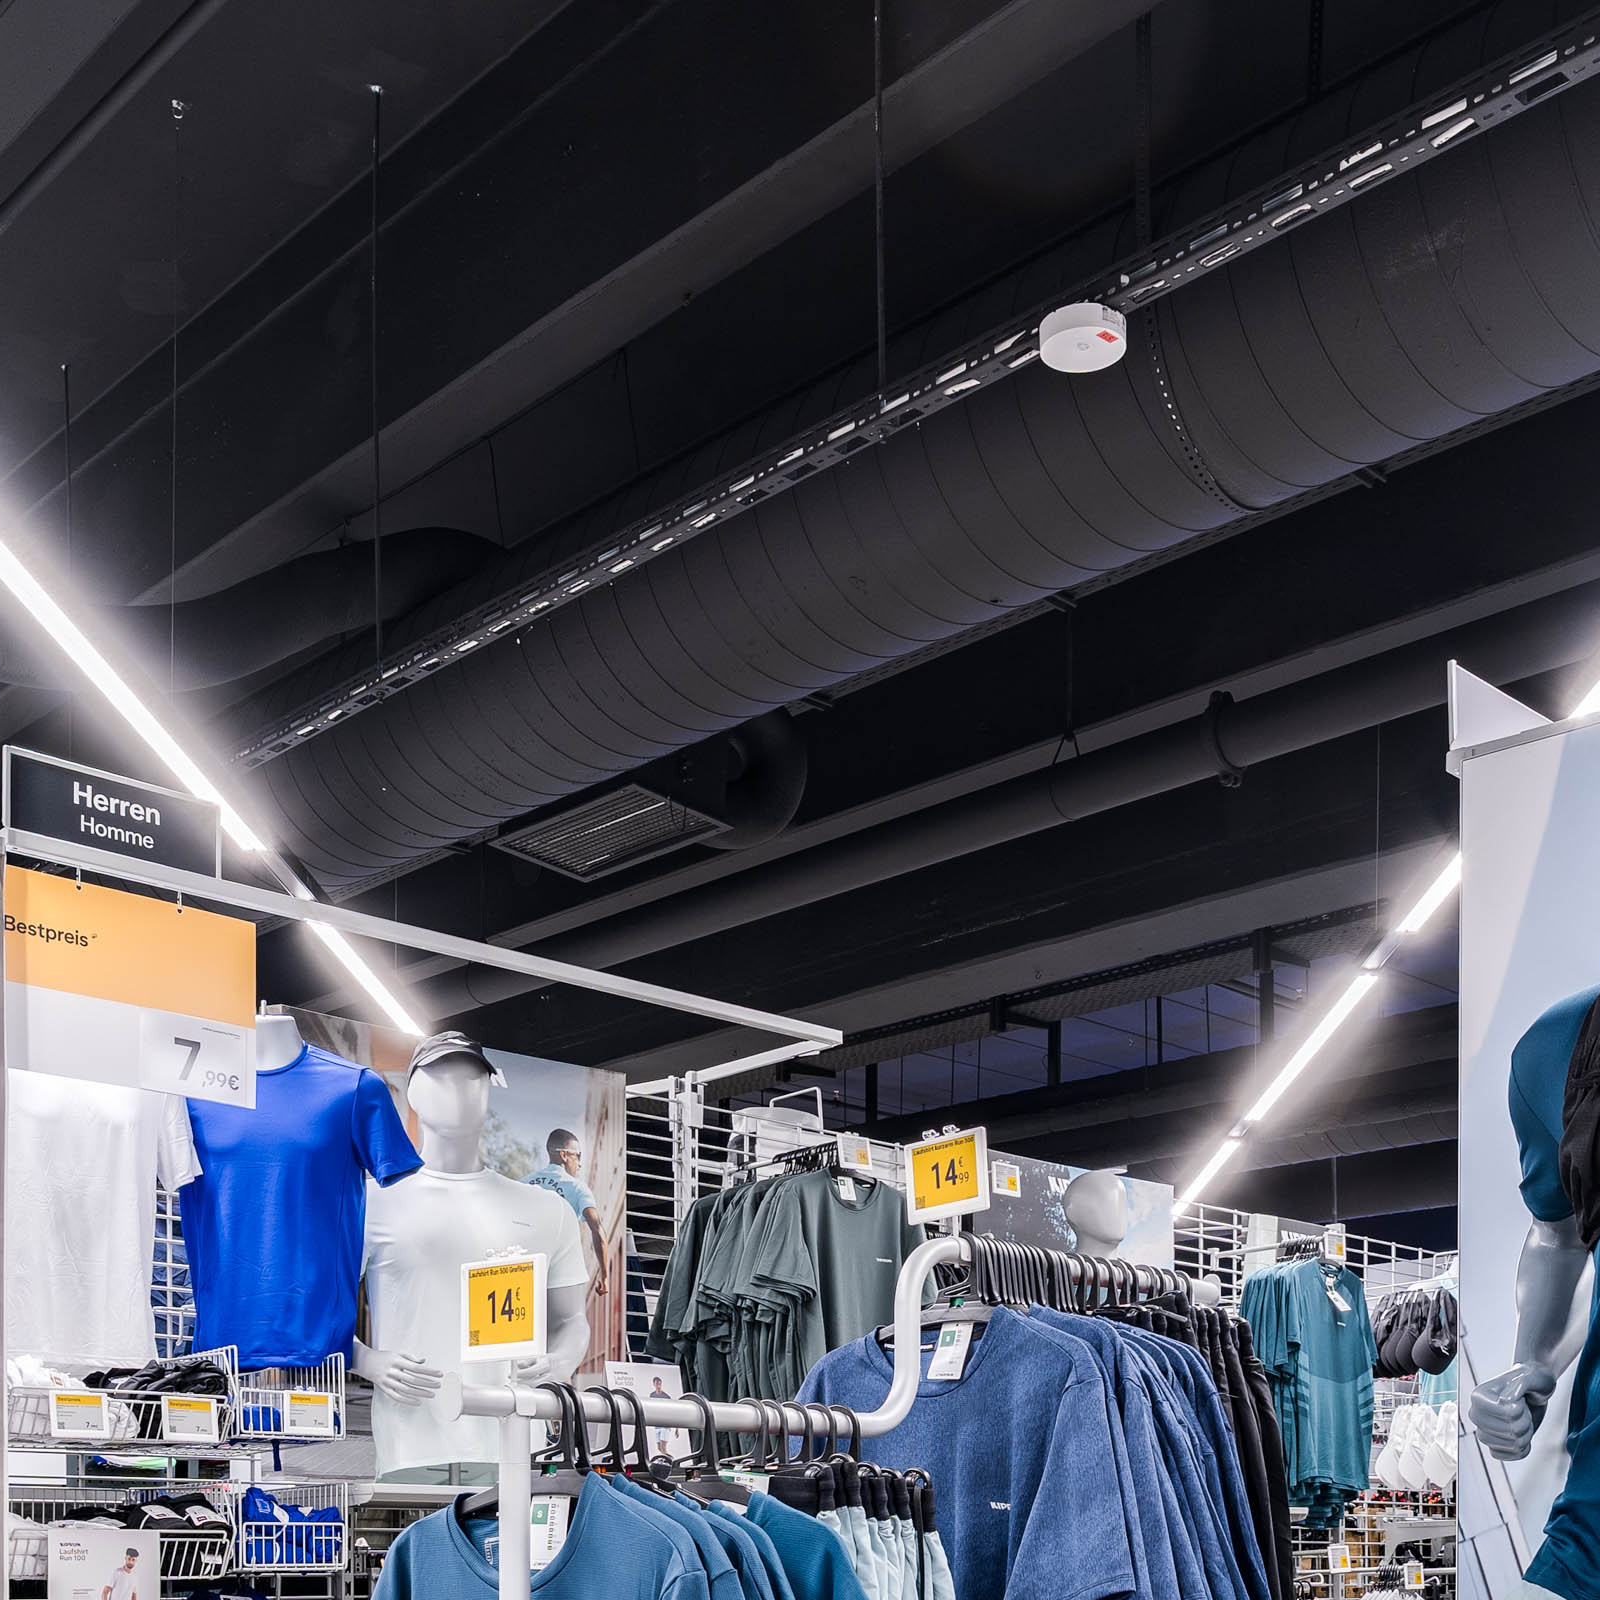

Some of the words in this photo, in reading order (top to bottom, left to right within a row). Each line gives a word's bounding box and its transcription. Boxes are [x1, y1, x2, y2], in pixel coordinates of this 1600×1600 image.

[72, 781, 161, 826] Herren
[79, 815, 155, 850] Homme
[931, 1158, 958, 1190] 14
[958, 1171, 970, 1184] 99
[487, 1288, 514, 1324] 14
[515, 1306, 526, 1321] 99
